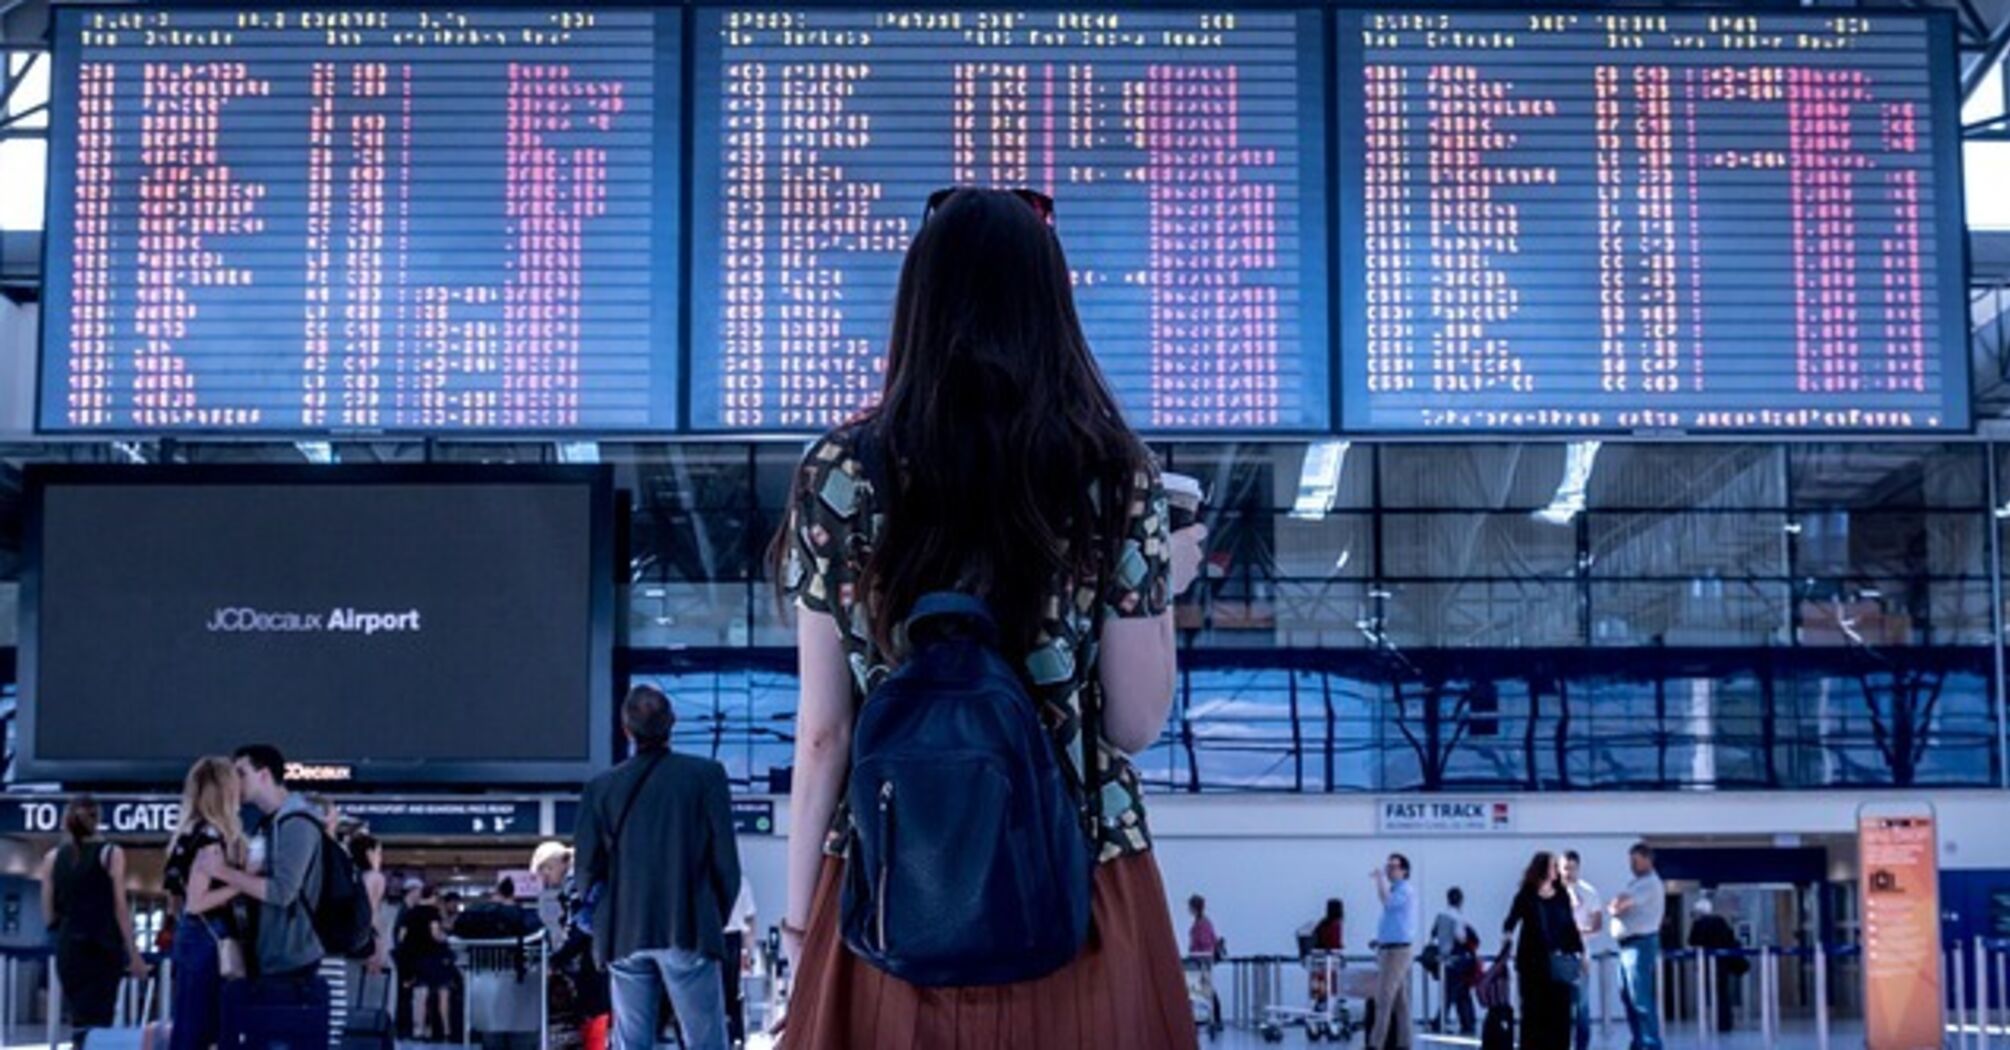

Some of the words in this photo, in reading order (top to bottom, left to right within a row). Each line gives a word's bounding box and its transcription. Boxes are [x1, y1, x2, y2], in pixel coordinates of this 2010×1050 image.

[207, 607, 323, 632] JCDecaux
[327, 607, 420, 635] Airport
[20, 803, 58, 831] TO
[112, 803, 181, 831] GATE
[1386, 803, 1425, 818] FAST
[1431, 803, 1484, 818] TRACK
